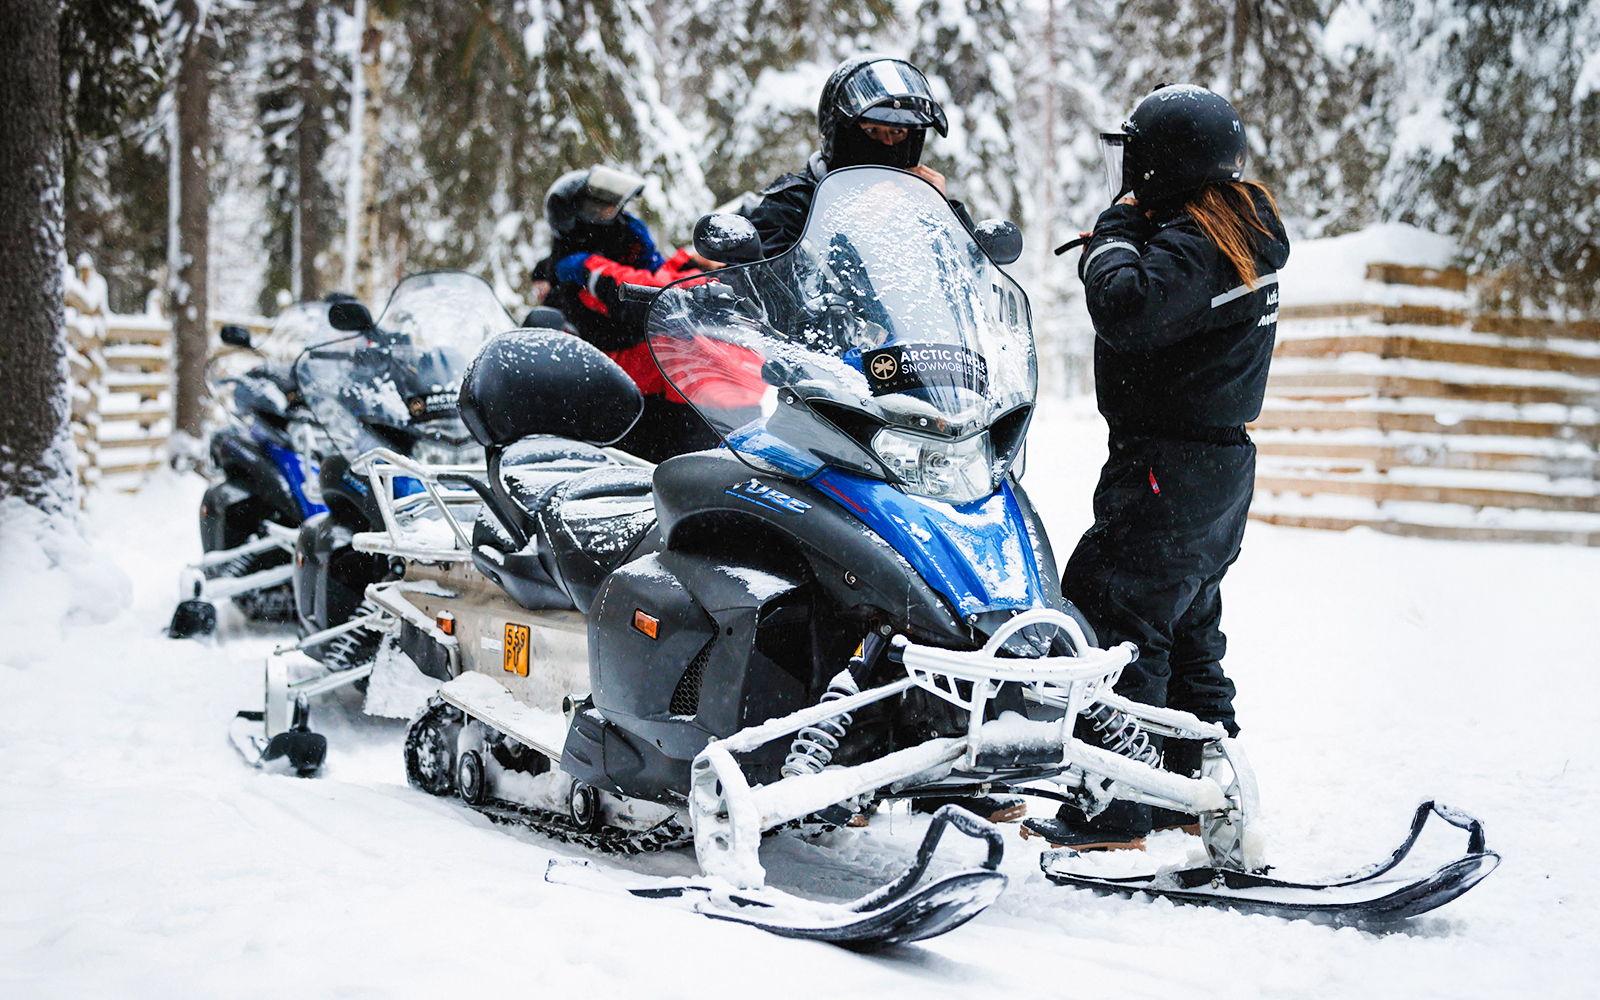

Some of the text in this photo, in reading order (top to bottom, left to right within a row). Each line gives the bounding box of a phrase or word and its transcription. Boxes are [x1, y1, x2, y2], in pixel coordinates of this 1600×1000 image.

[1231, 120, 1241, 132] M
[901, 350, 952, 363] ARCTIC
[901, 360, 973, 376] SNOWMOBILE
[506, 628, 526, 648] 559
